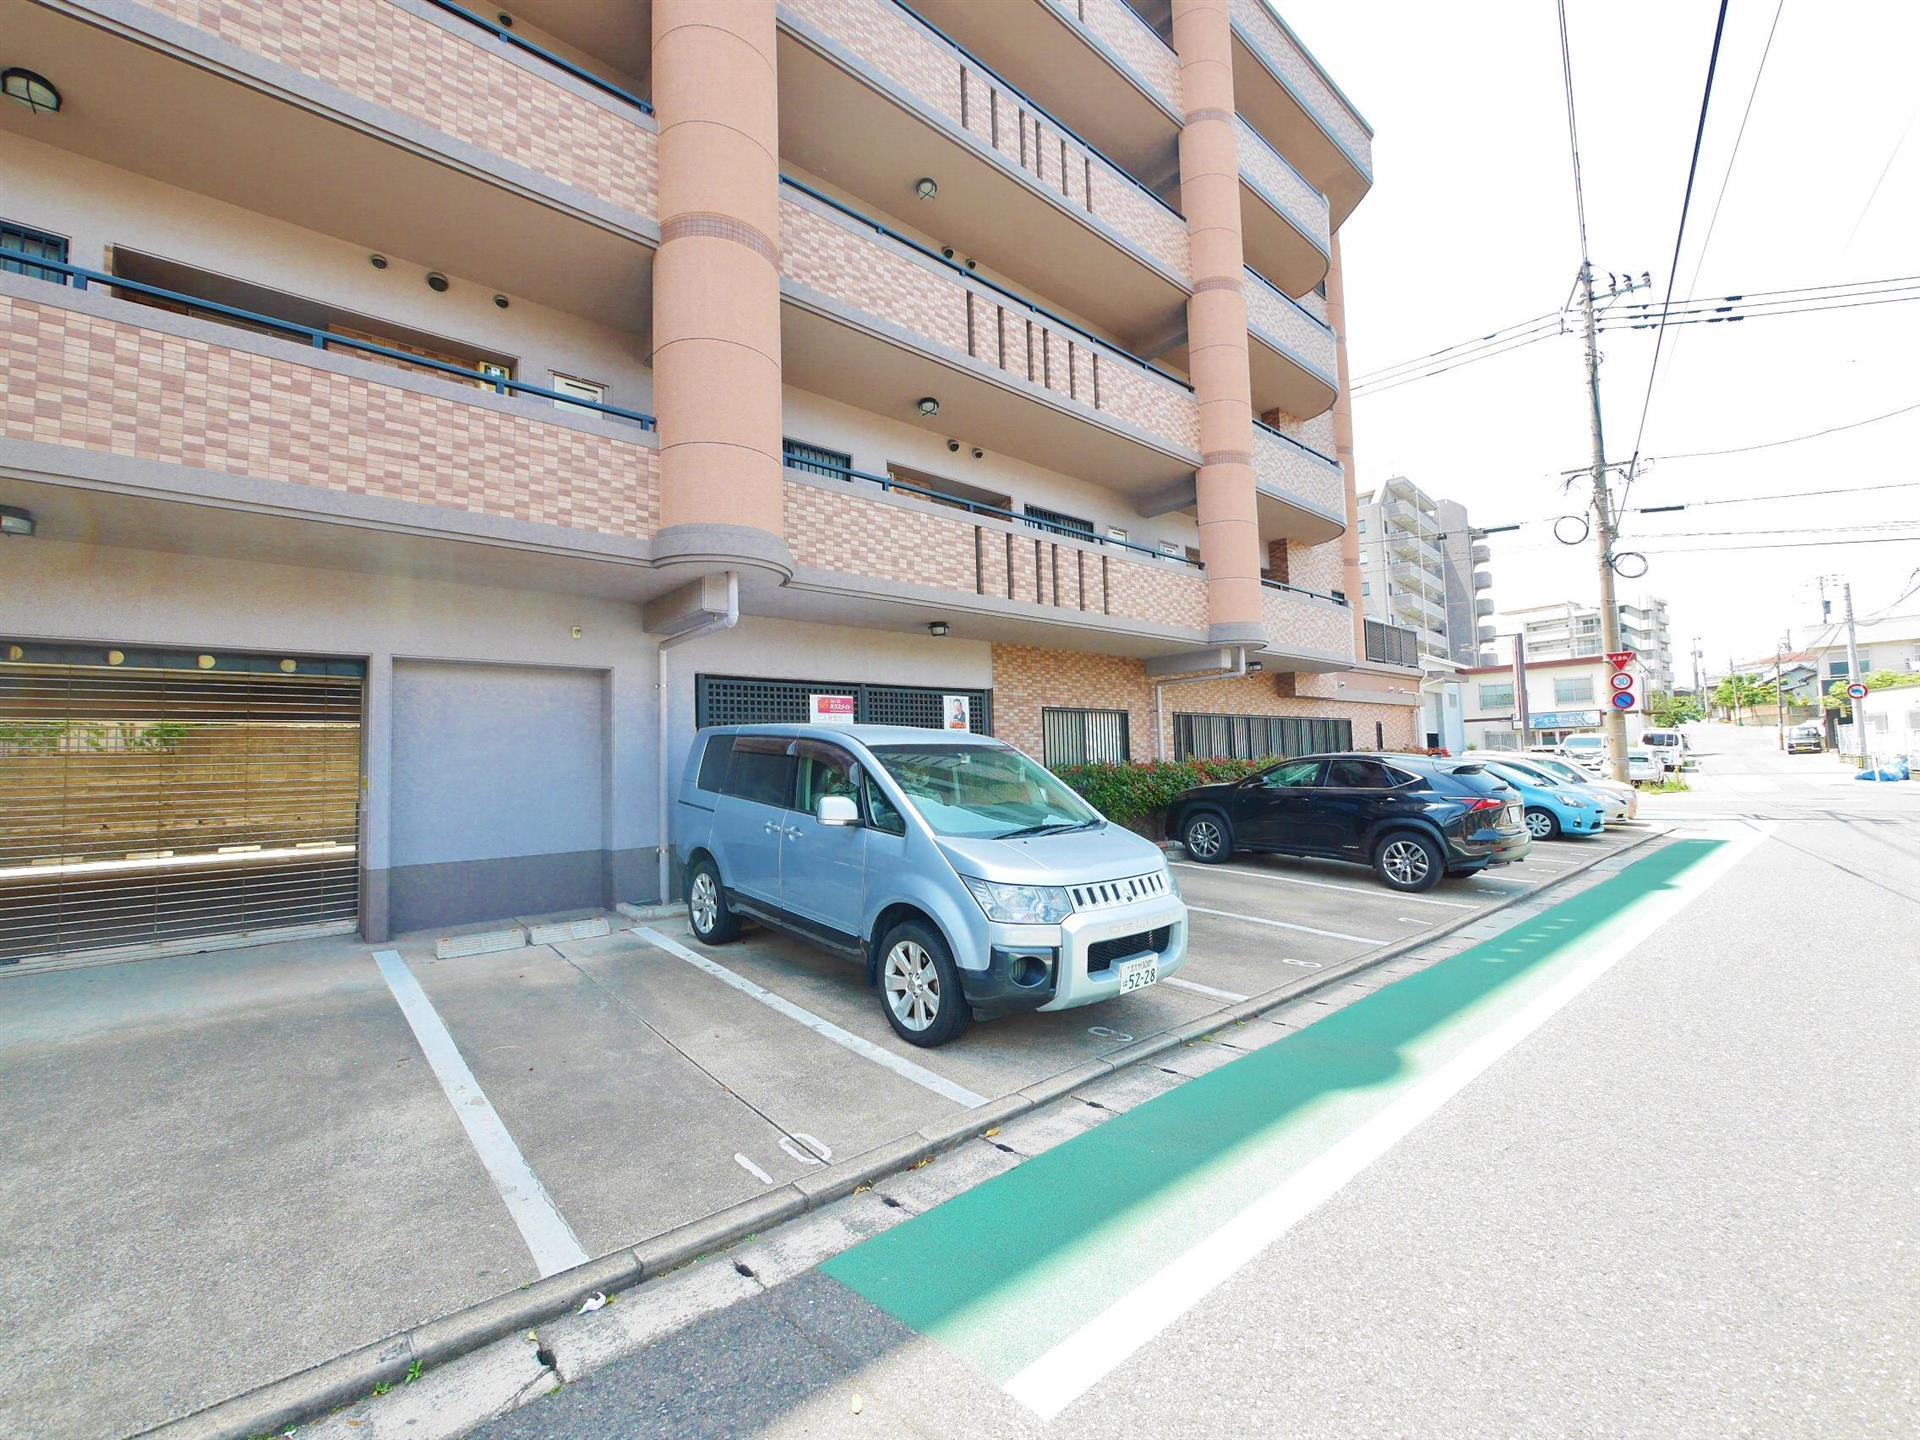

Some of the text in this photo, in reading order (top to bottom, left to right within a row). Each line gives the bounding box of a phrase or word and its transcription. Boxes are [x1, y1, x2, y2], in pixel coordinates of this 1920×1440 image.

[1616, 677, 1629, 687] 30
[1282, 958, 1322, 968] 8
[1129, 967, 1156, 990] 52-28
